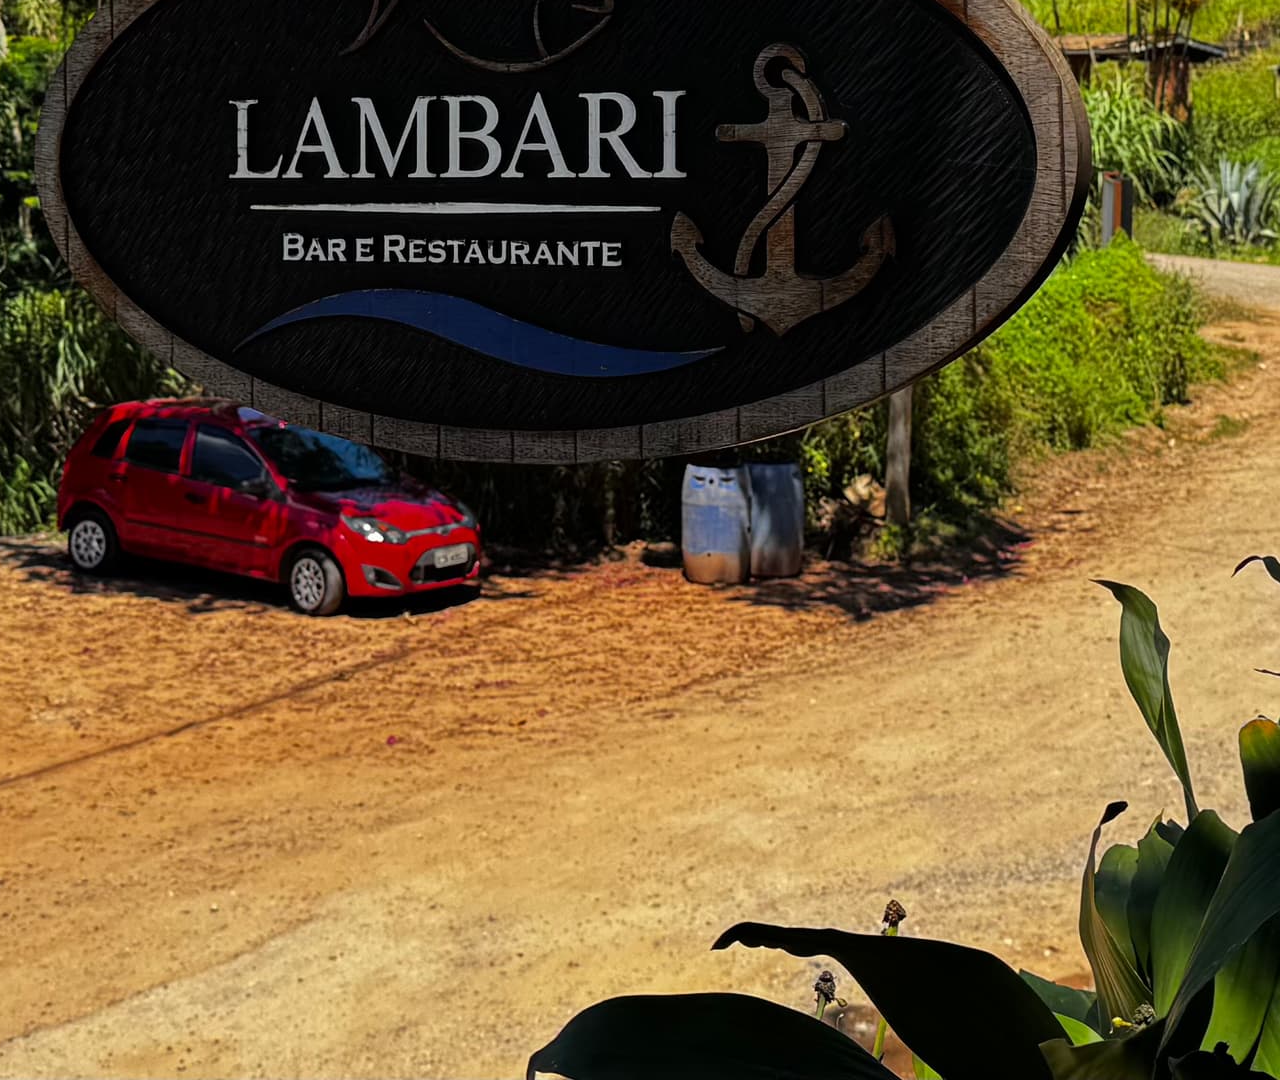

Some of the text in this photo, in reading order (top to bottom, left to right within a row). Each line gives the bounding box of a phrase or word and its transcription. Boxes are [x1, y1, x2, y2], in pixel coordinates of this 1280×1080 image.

[228, 90, 687, 180] LAMBARI
[281, 232, 623, 268] BAR E RESTAURANTE
